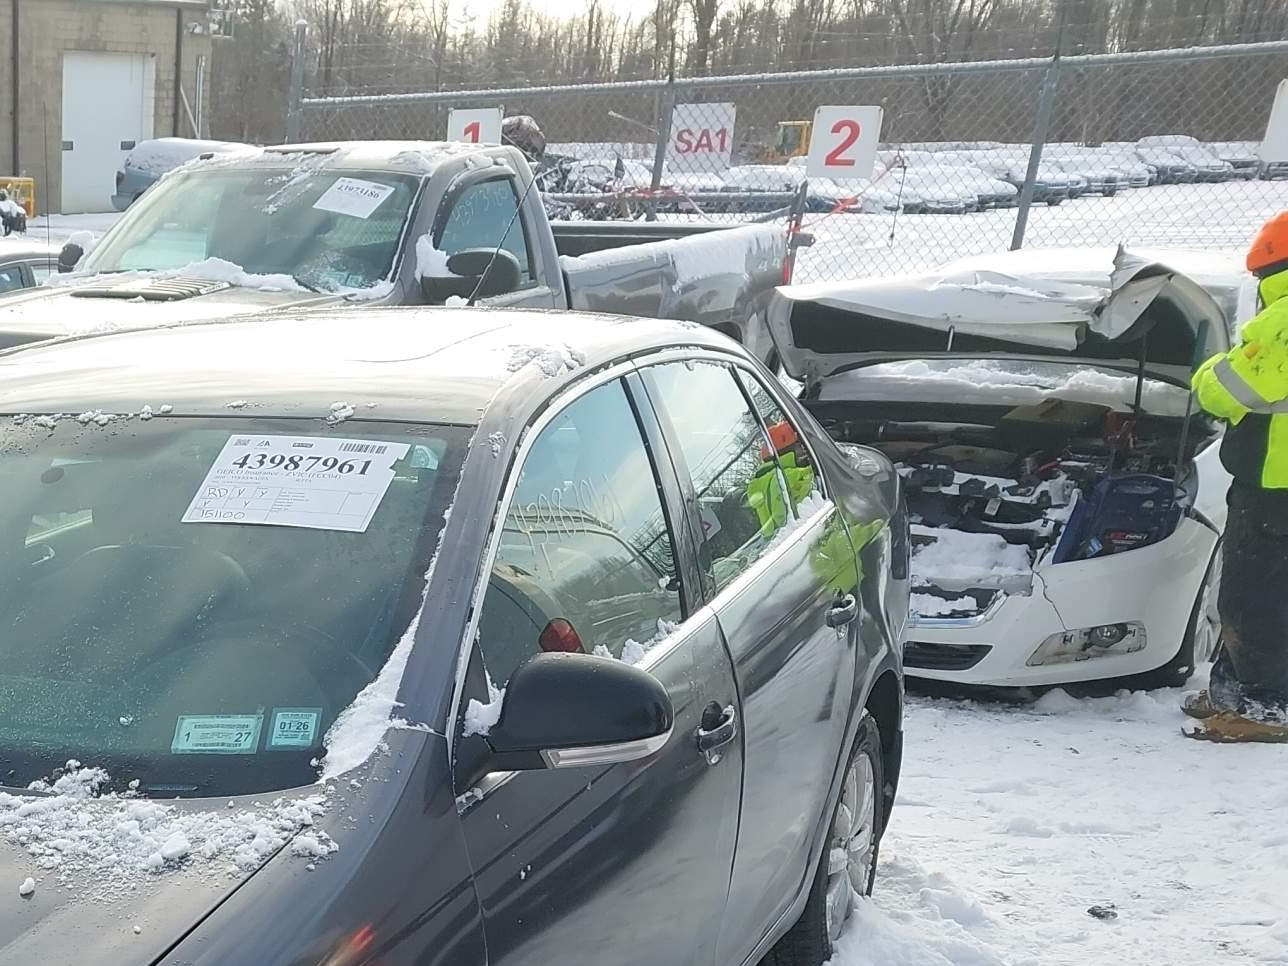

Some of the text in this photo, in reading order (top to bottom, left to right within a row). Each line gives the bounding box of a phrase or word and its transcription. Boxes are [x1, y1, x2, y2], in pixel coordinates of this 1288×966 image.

[674, 127, 728, 154] SA1
[824, 119, 861, 166] 2
[232, 453, 373, 476] 43987961
[184, 731, 192, 743] 1
[234, 731, 252, 743] 27
